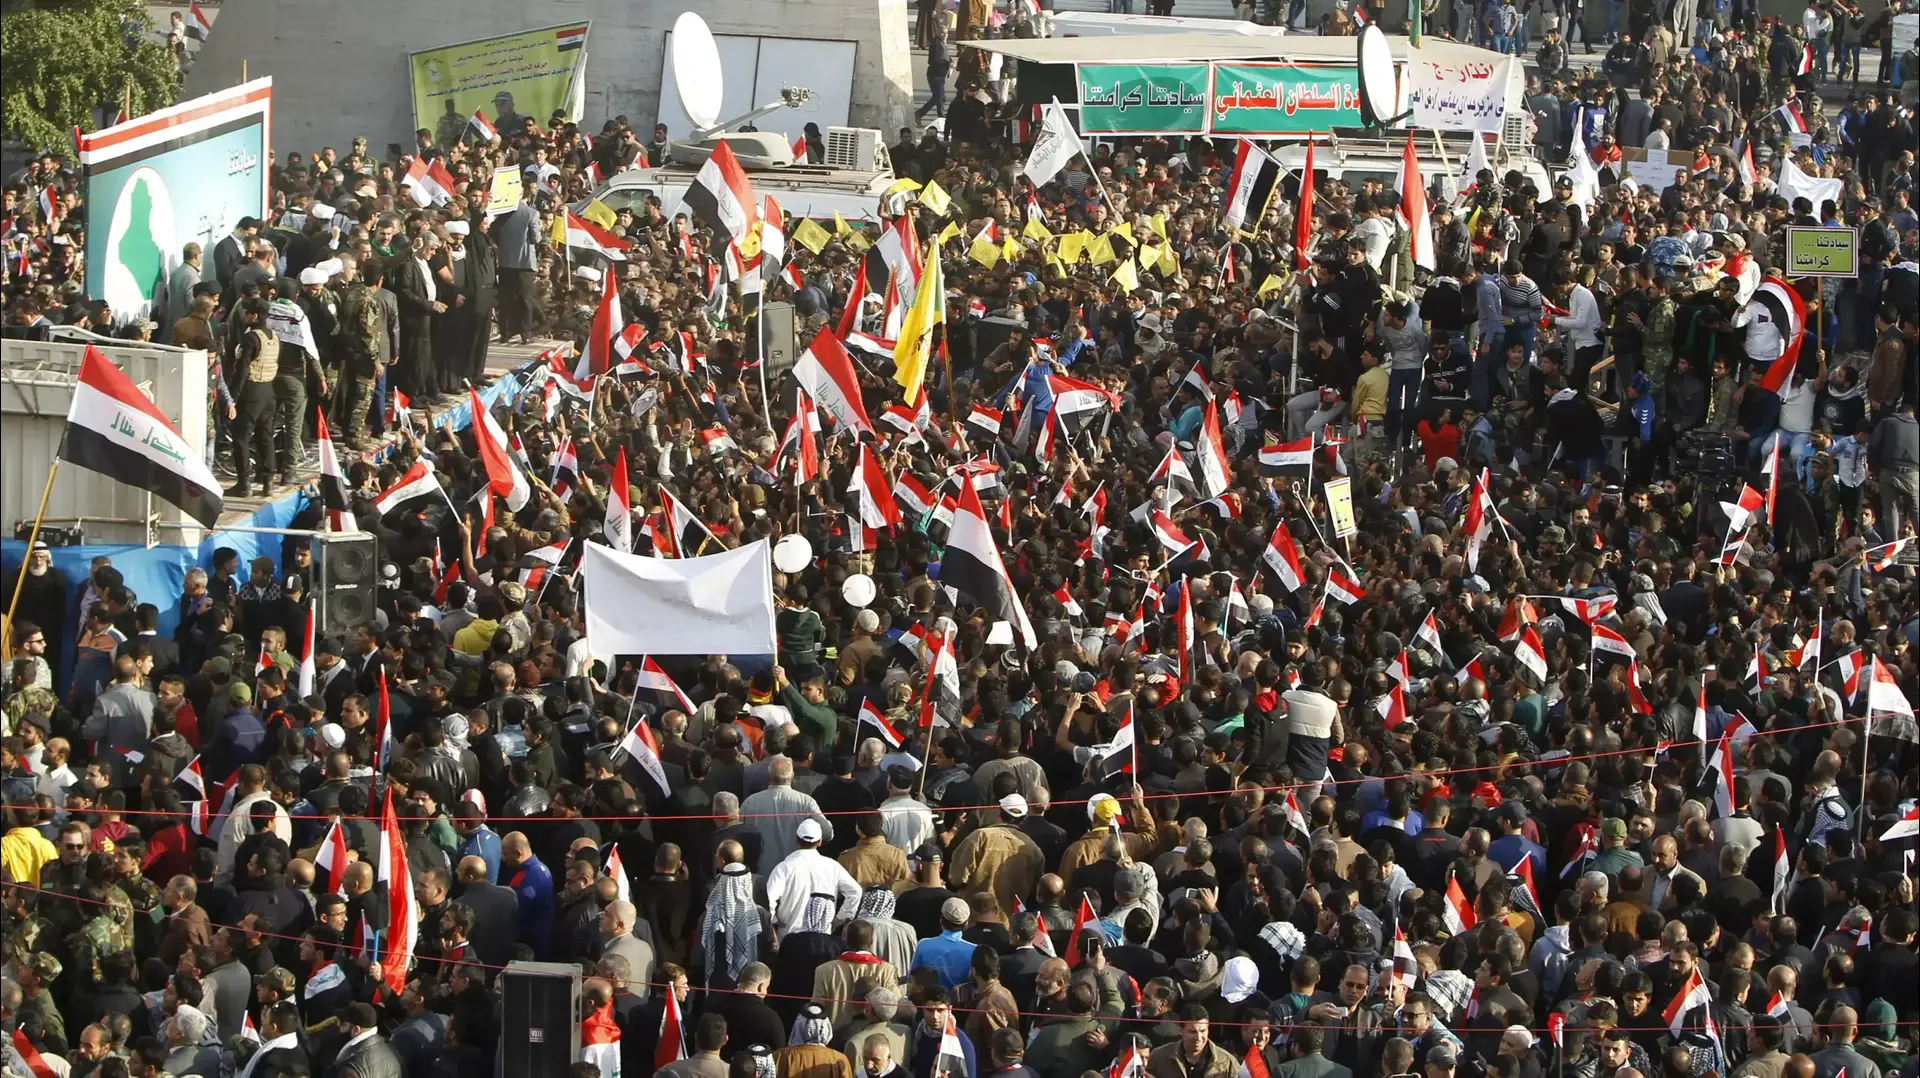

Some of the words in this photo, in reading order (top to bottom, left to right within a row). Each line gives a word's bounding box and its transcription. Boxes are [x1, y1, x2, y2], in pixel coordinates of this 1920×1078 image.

[1081, 80, 1143, 112] كرامتنا
[1148, 80, 1206, 114] سيادتنا
[1215, 81, 1283, 121] العثماني
[1285, 82, 1341, 116] السلطان
[228, 143, 256, 176] سيادتنا
[1816, 236, 1849, 251] سيادتنا
[1796, 254, 1830, 269] كرامتنا
